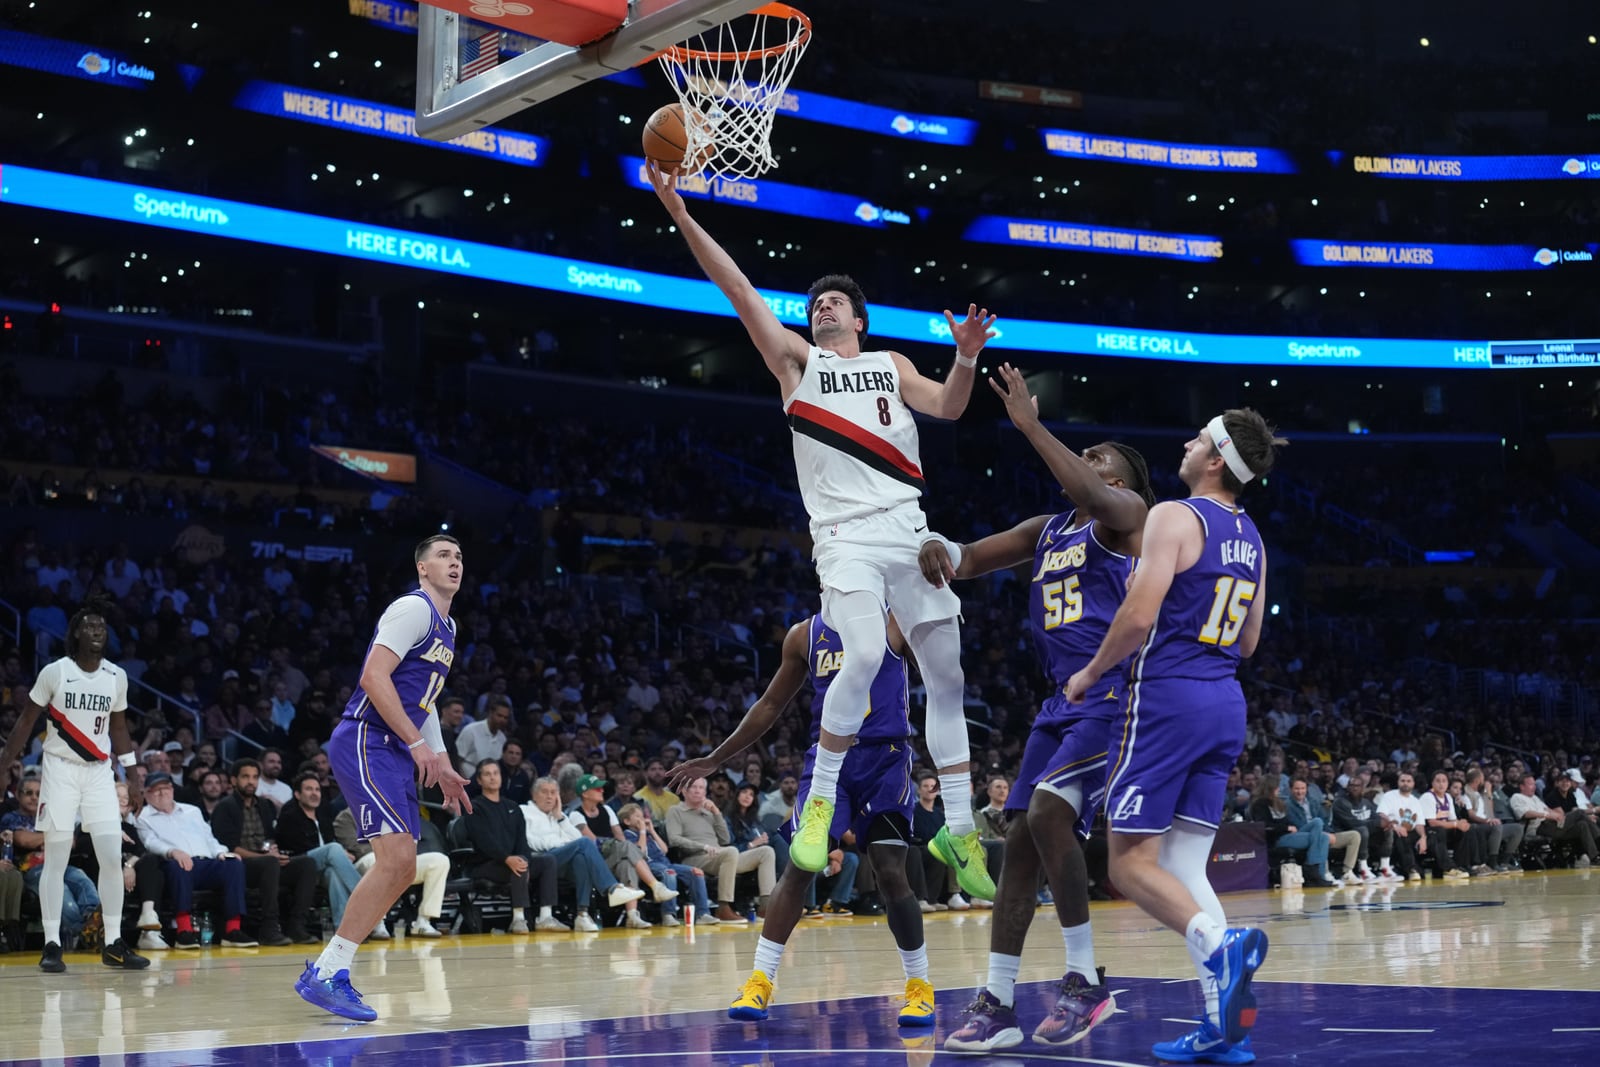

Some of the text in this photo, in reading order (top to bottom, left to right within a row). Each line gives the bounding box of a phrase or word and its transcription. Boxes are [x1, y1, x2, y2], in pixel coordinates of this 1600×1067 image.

[283, 91, 330, 120] WHERE
[332, 101, 383, 130] LAKERS
[497, 134, 538, 161] YOURS
[1045, 133, 1258, 167] WHERE LAKERS HISTORY BECOMES YOURS
[1353, 155, 1462, 177] GOLDIN.COM/LAKERS
[133, 191, 229, 225] Spectrum
[346, 229, 471, 268] HERE FOR LA.
[1008, 222, 1224, 258] WHERE LAKERS HISTORY BECOMES YOURS
[1322, 244, 1434, 265] GOLDIN.COM/LAKERS
[567, 265, 643, 294] Spectrum
[785, 300, 808, 319] FO
[1096, 332, 1199, 356] HERE FOR LA.
[1287, 341, 1361, 360] Spectrum
[1504, 354, 1534, 366] Happy
[1536, 353, 1556, 364] 10th
[1557, 351, 1595, 364] Birthday
[818, 370, 895, 395] BLAZERS
[876, 395, 892, 427] 8
[1031, 542, 1087, 582] LAKERS
[1042, 574, 1083, 631] 55
[1198, 575, 1257, 647] 15
[420, 637, 455, 671] LAKE
[815, 648, 846, 678] LAK
[64, 691, 112, 713] BLAZERS
[93, 715, 108, 736] 91
